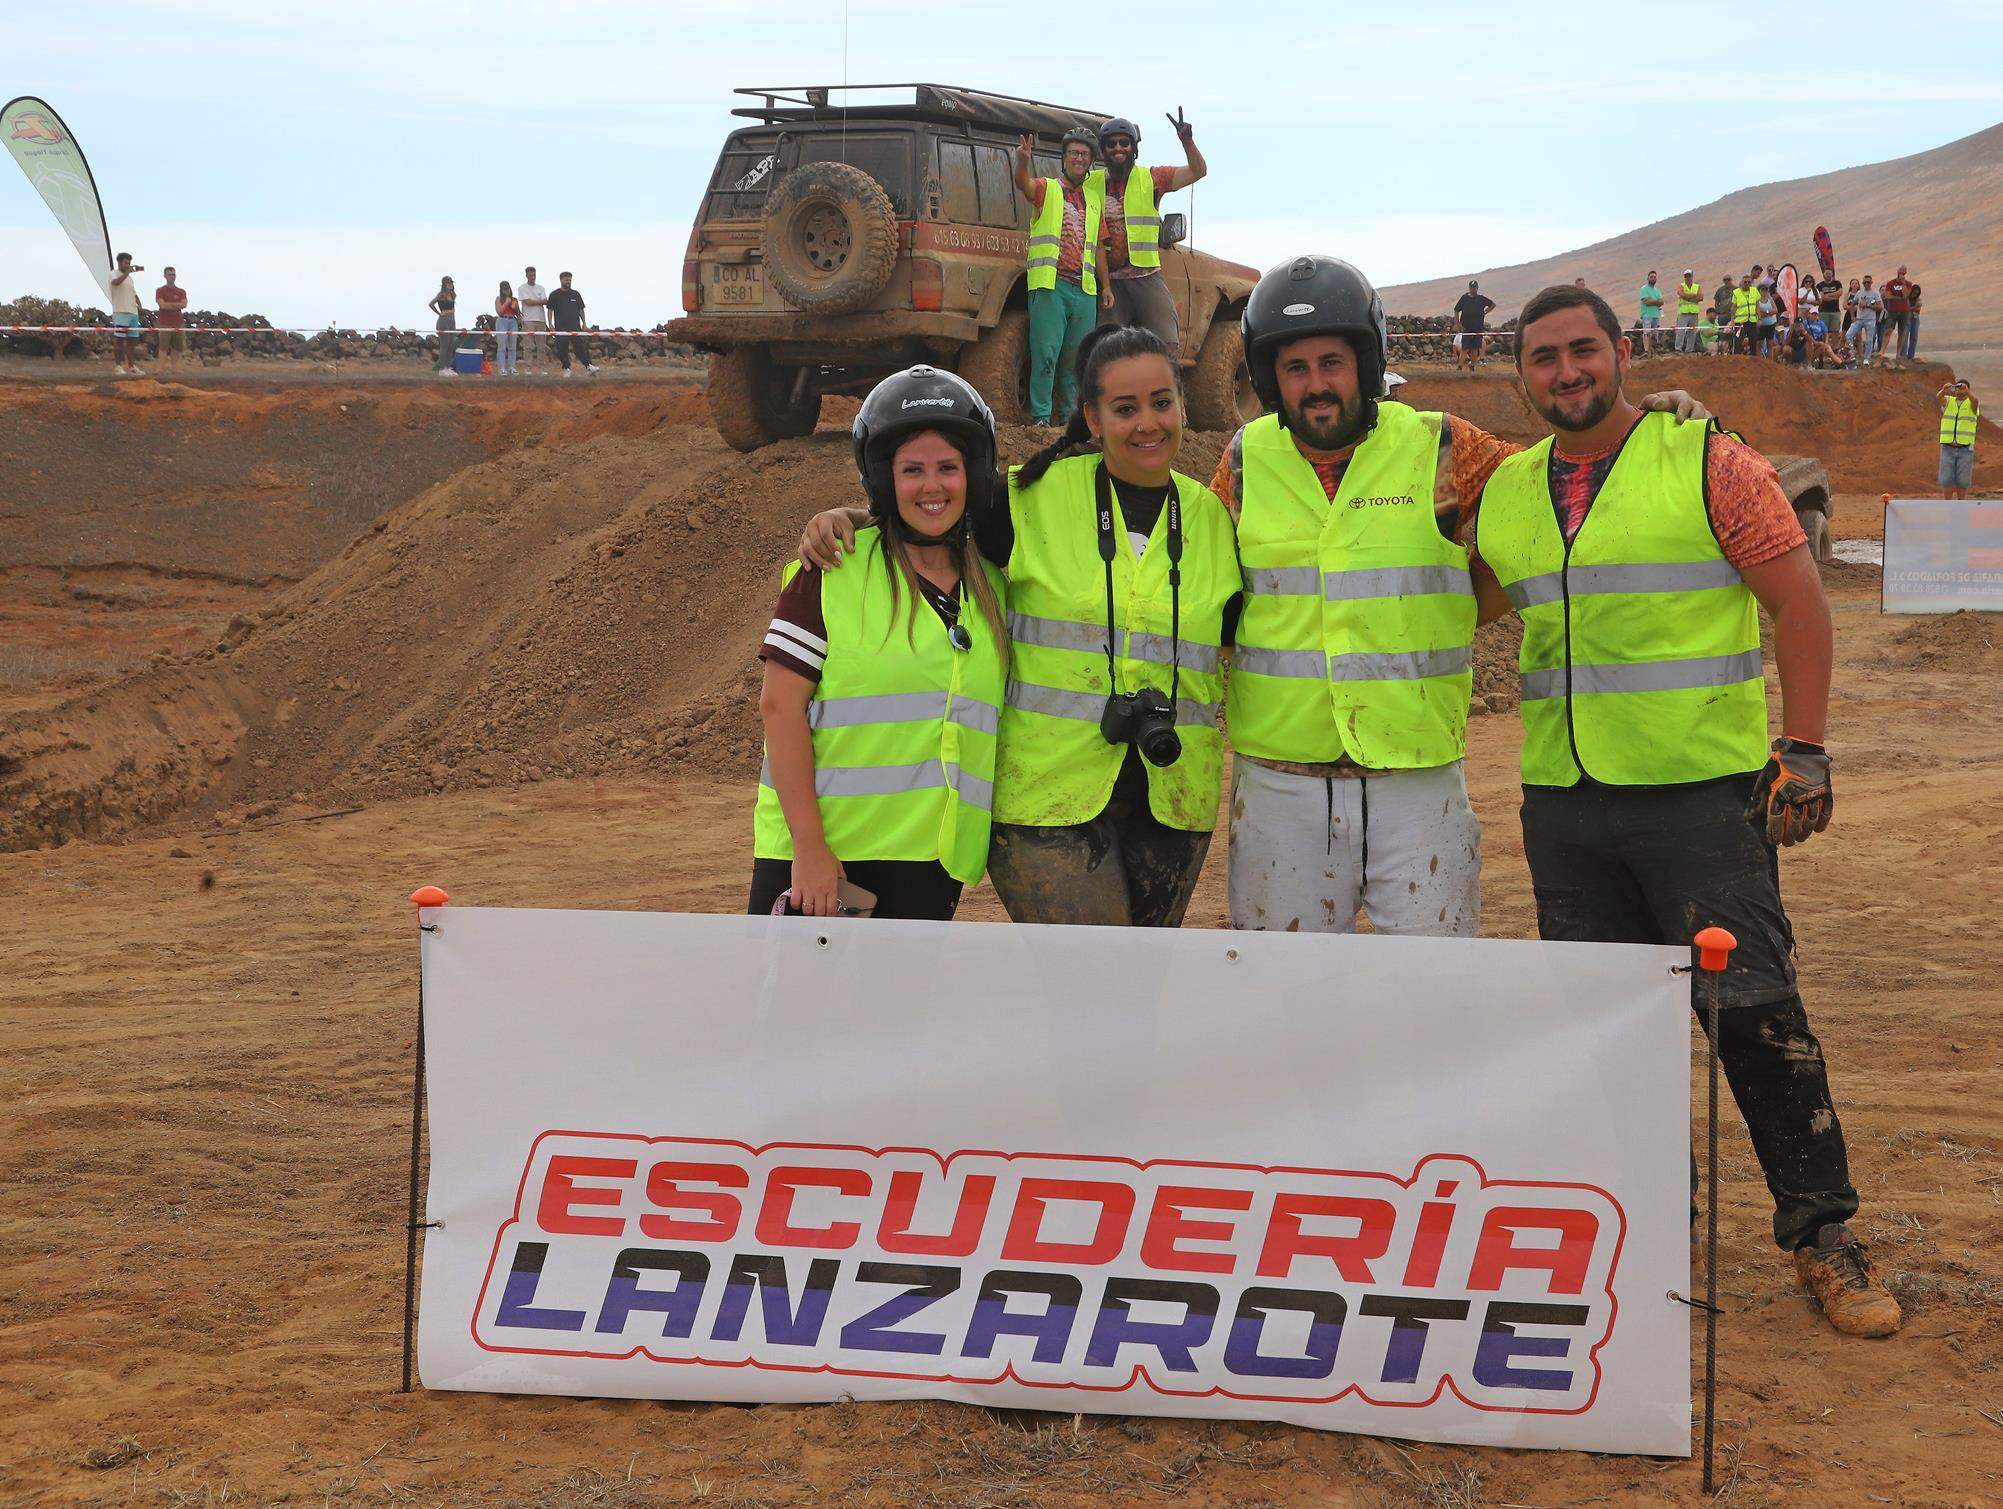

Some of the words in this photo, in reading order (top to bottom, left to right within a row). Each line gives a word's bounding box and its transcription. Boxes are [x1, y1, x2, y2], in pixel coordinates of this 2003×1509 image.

[722, 267, 739, 282] CO
[744, 267, 760, 282] AL
[722, 286, 753, 300] 9581
[1368, 496, 1415, 507] TOYOTA
[1101, 510, 1110, 531] EOS
[537, 1155, 1600, 1295] ESCUDERÍA
[495, 1241, 1590, 1391] LANZAROTE
